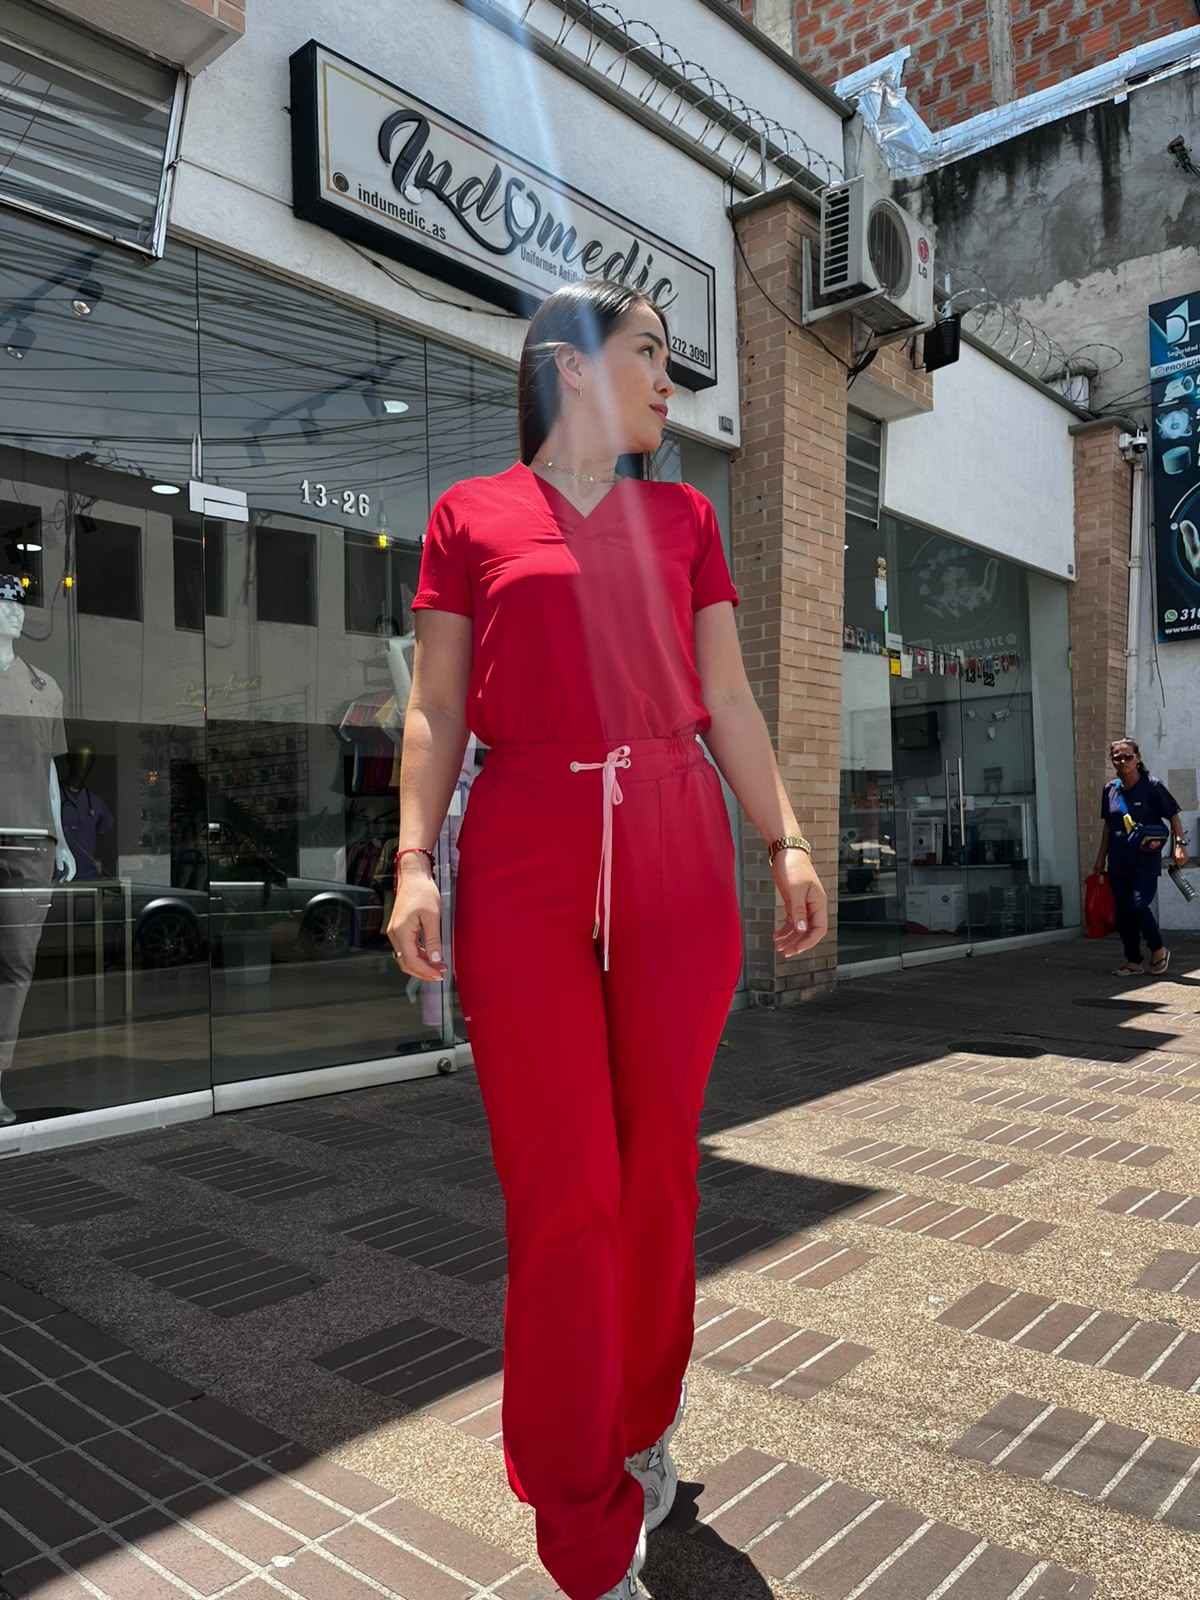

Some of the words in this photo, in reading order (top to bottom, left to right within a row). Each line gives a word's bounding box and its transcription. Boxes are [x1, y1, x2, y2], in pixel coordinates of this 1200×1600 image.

[358, 183, 447, 240] indumedic_as
[520, 245, 558, 276] Uniformes
[918, 263, 928, 279] LG
[672, 336, 687, 354] 272
[689, 344, 708, 365] 3091
[301, 479, 371, 518] 13-26
